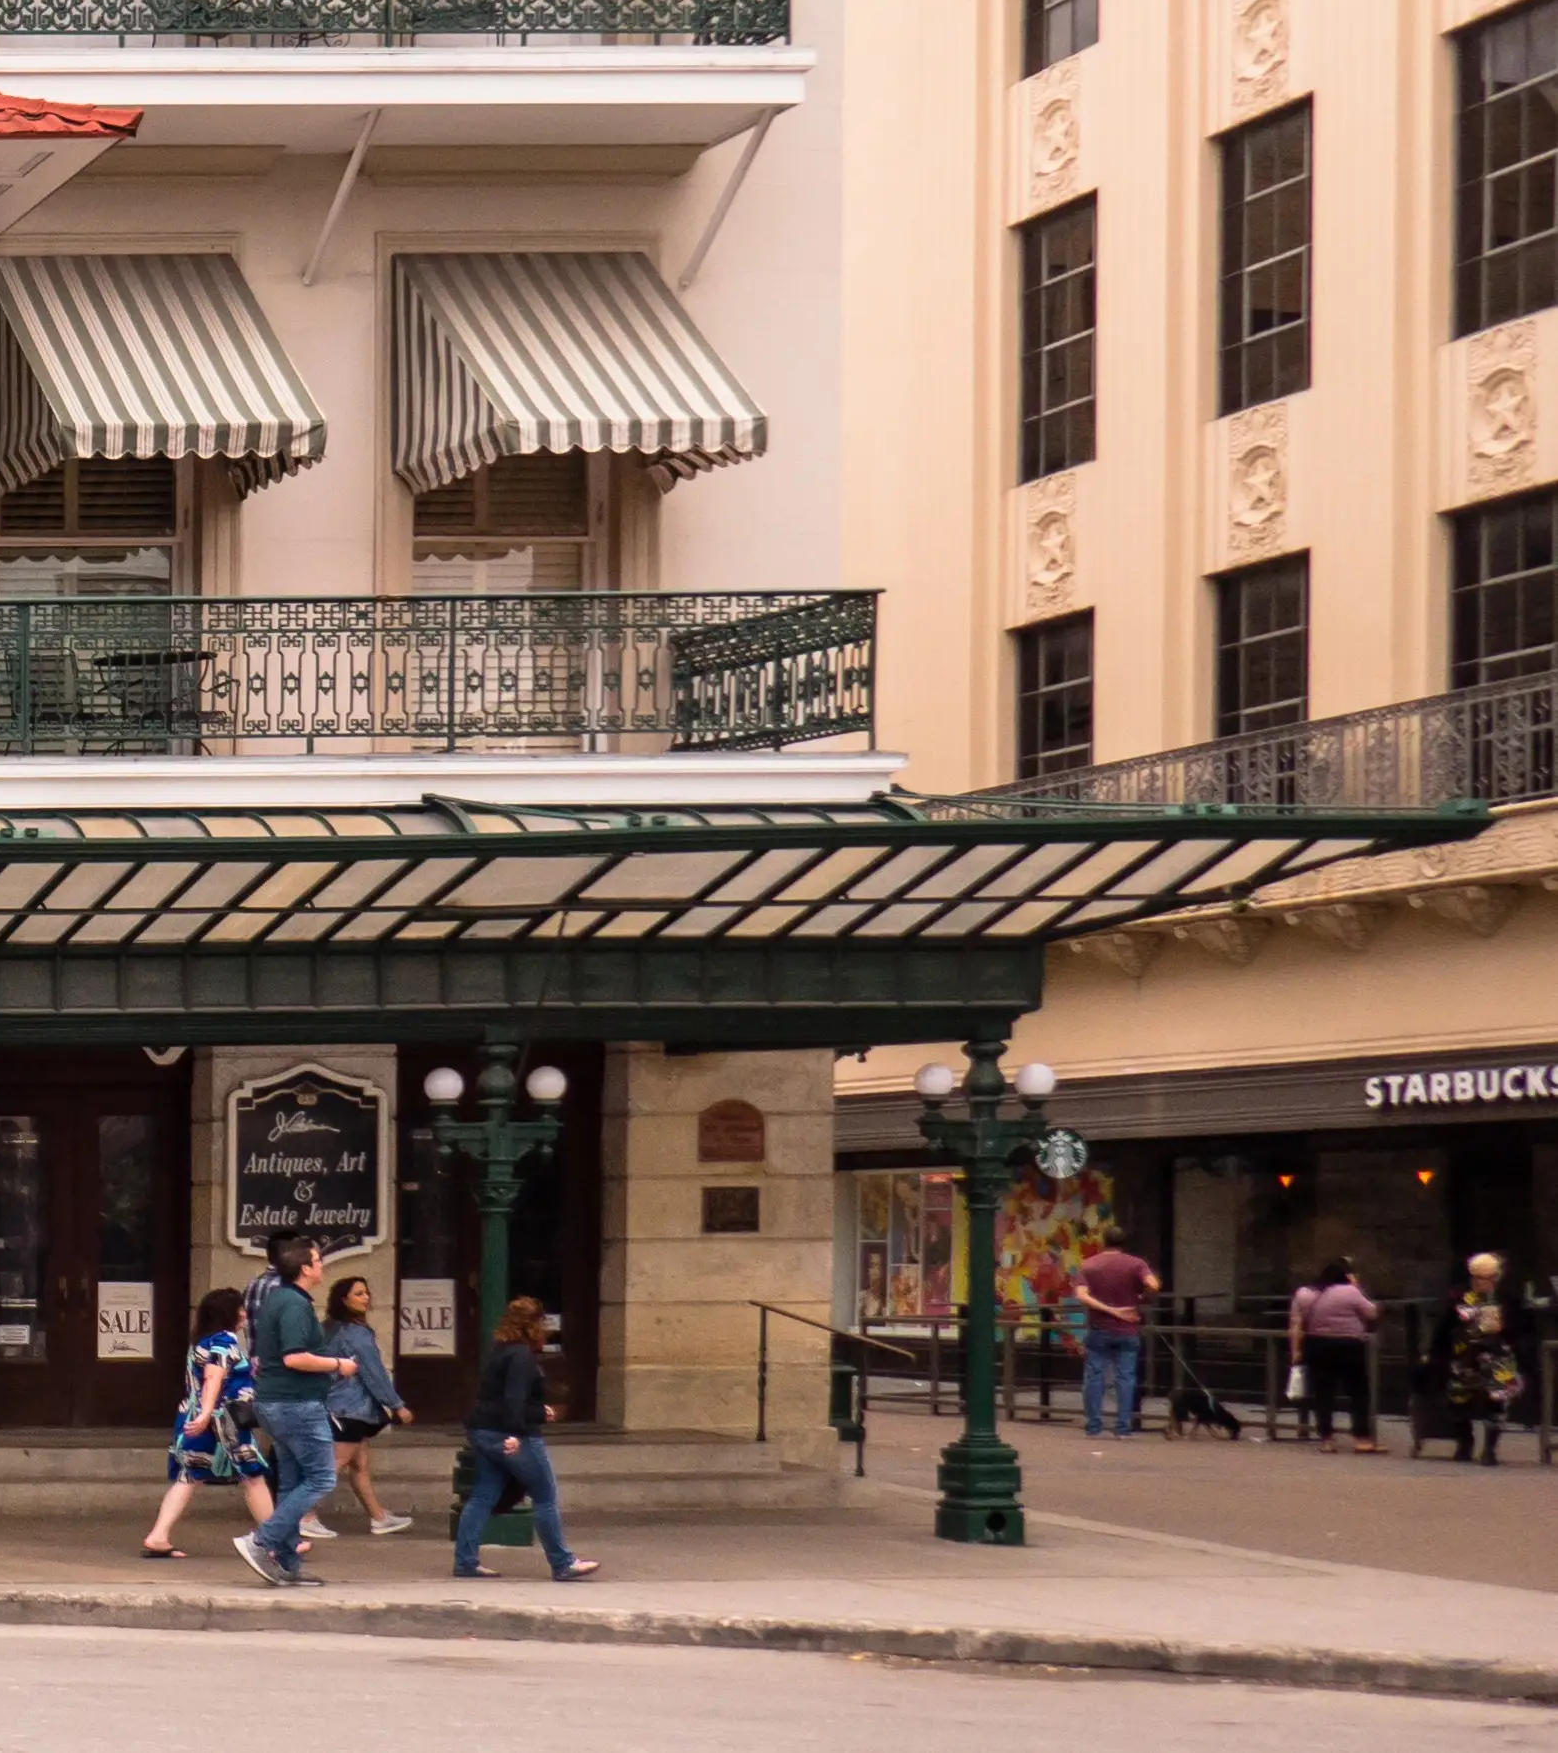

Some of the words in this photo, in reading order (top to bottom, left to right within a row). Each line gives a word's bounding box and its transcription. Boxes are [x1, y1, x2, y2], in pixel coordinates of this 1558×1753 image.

[243, 1151, 328, 1178] Antiques,
[335, 1150, 367, 1172] Art
[293, 1180, 316, 1203] &
[239, 1203, 298, 1226] Estate
[304, 1202, 371, 1228] Jewelry
[99, 1309, 151, 1334] SALE
[400, 1306, 453, 1331] SALE
